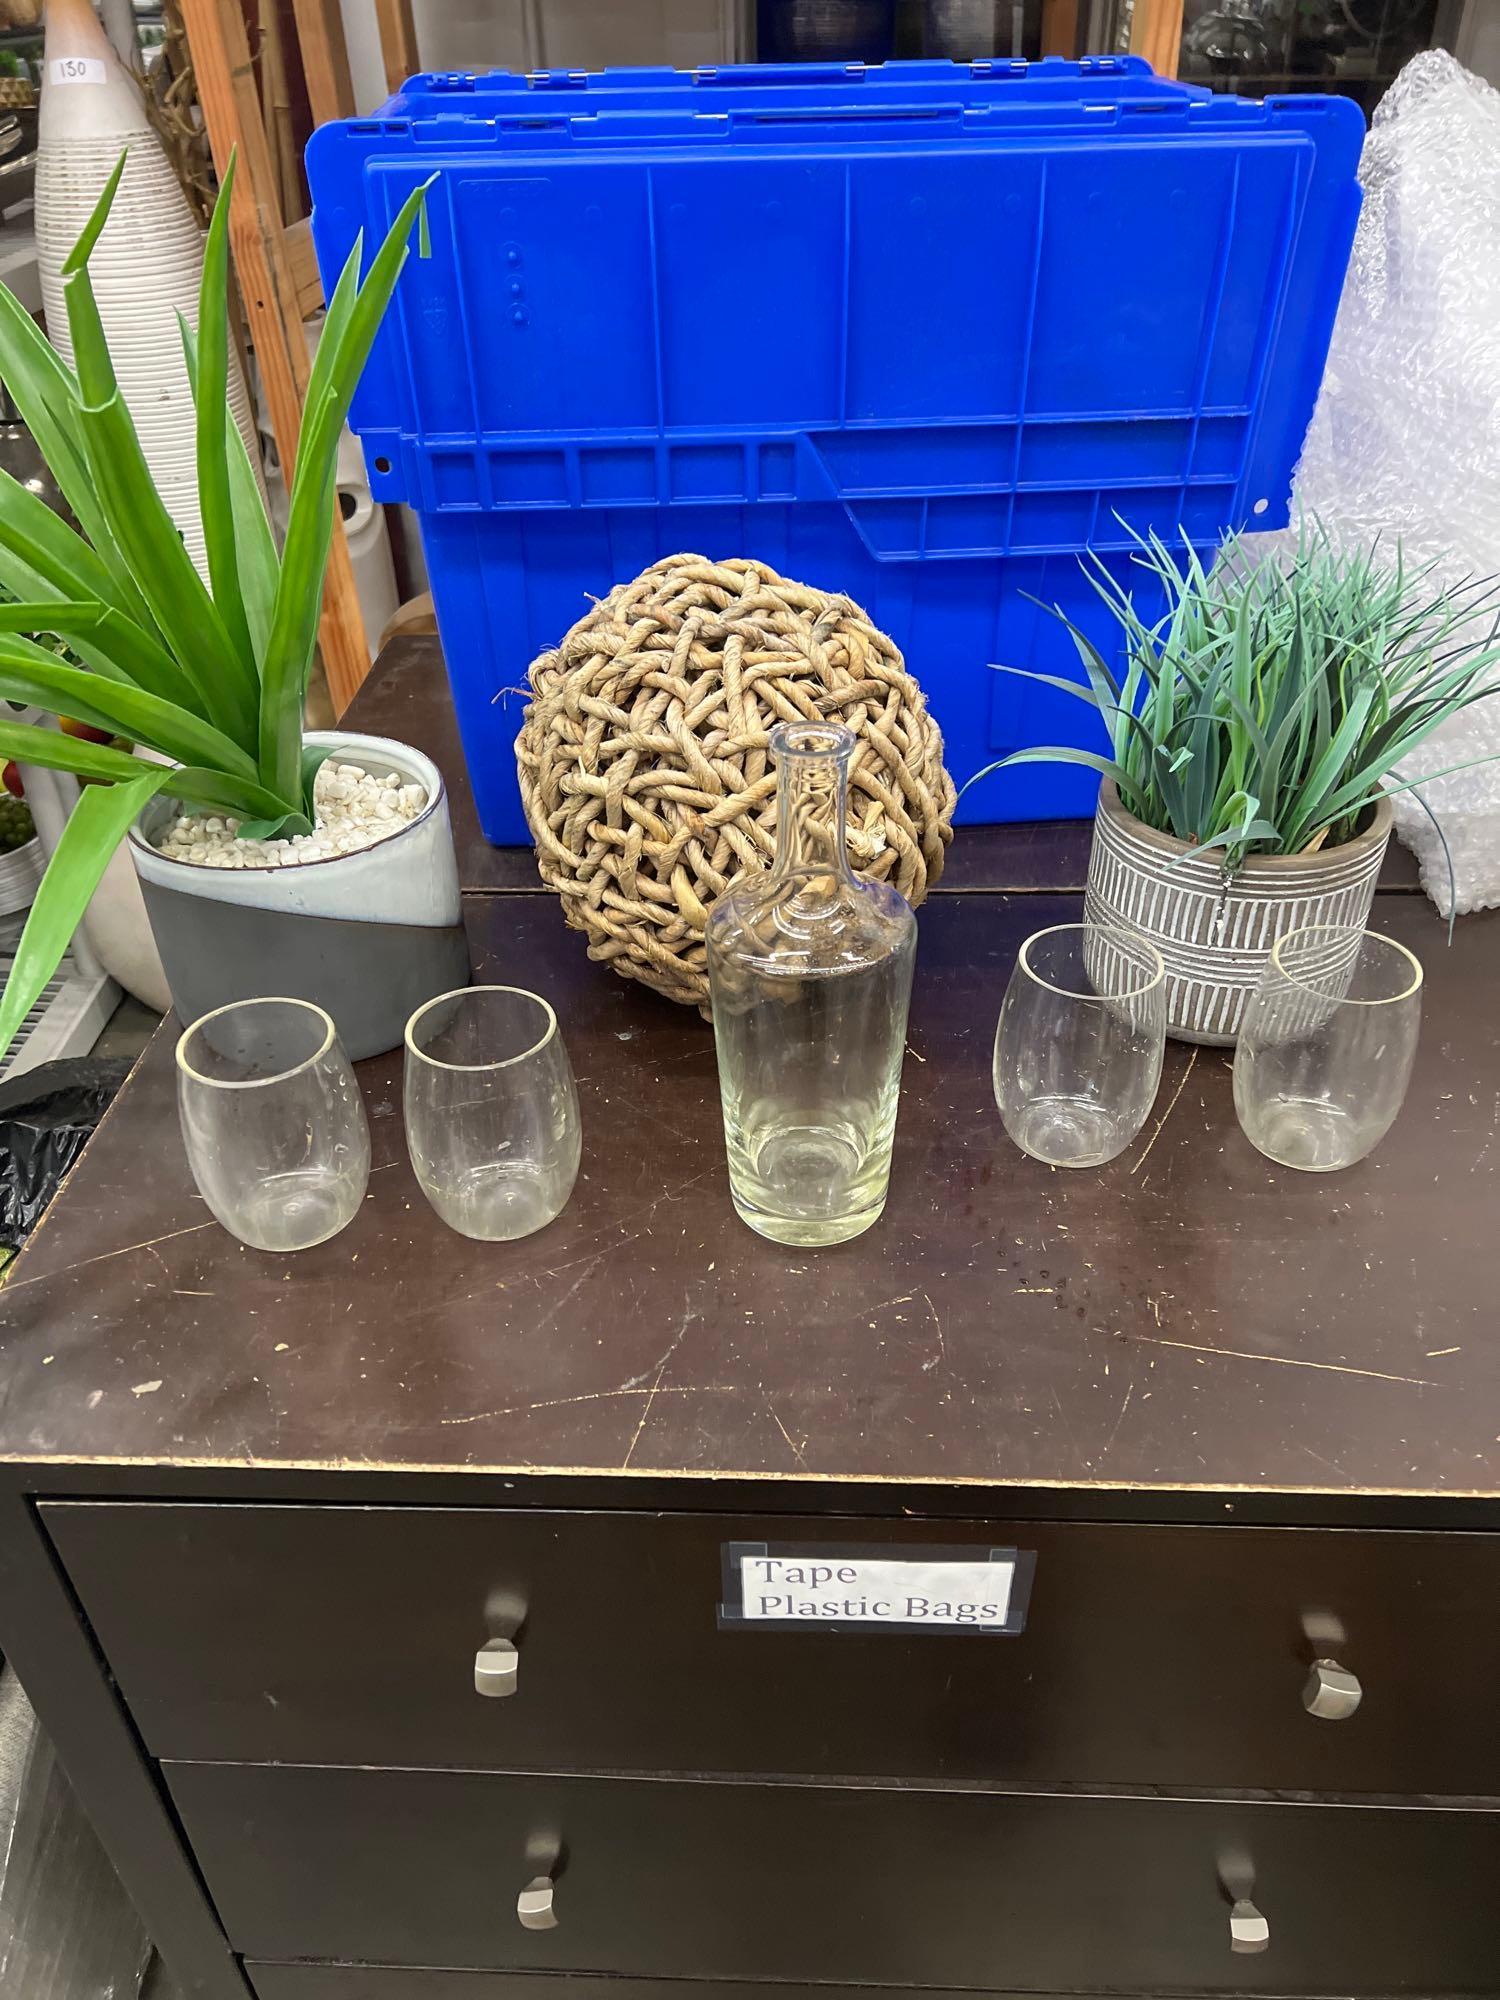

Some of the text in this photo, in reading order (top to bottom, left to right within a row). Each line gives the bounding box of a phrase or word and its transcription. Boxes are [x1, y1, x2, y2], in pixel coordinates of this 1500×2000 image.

[755, 1560, 857, 1590] Tape
[758, 1594, 998, 1623] Plastic Bags
